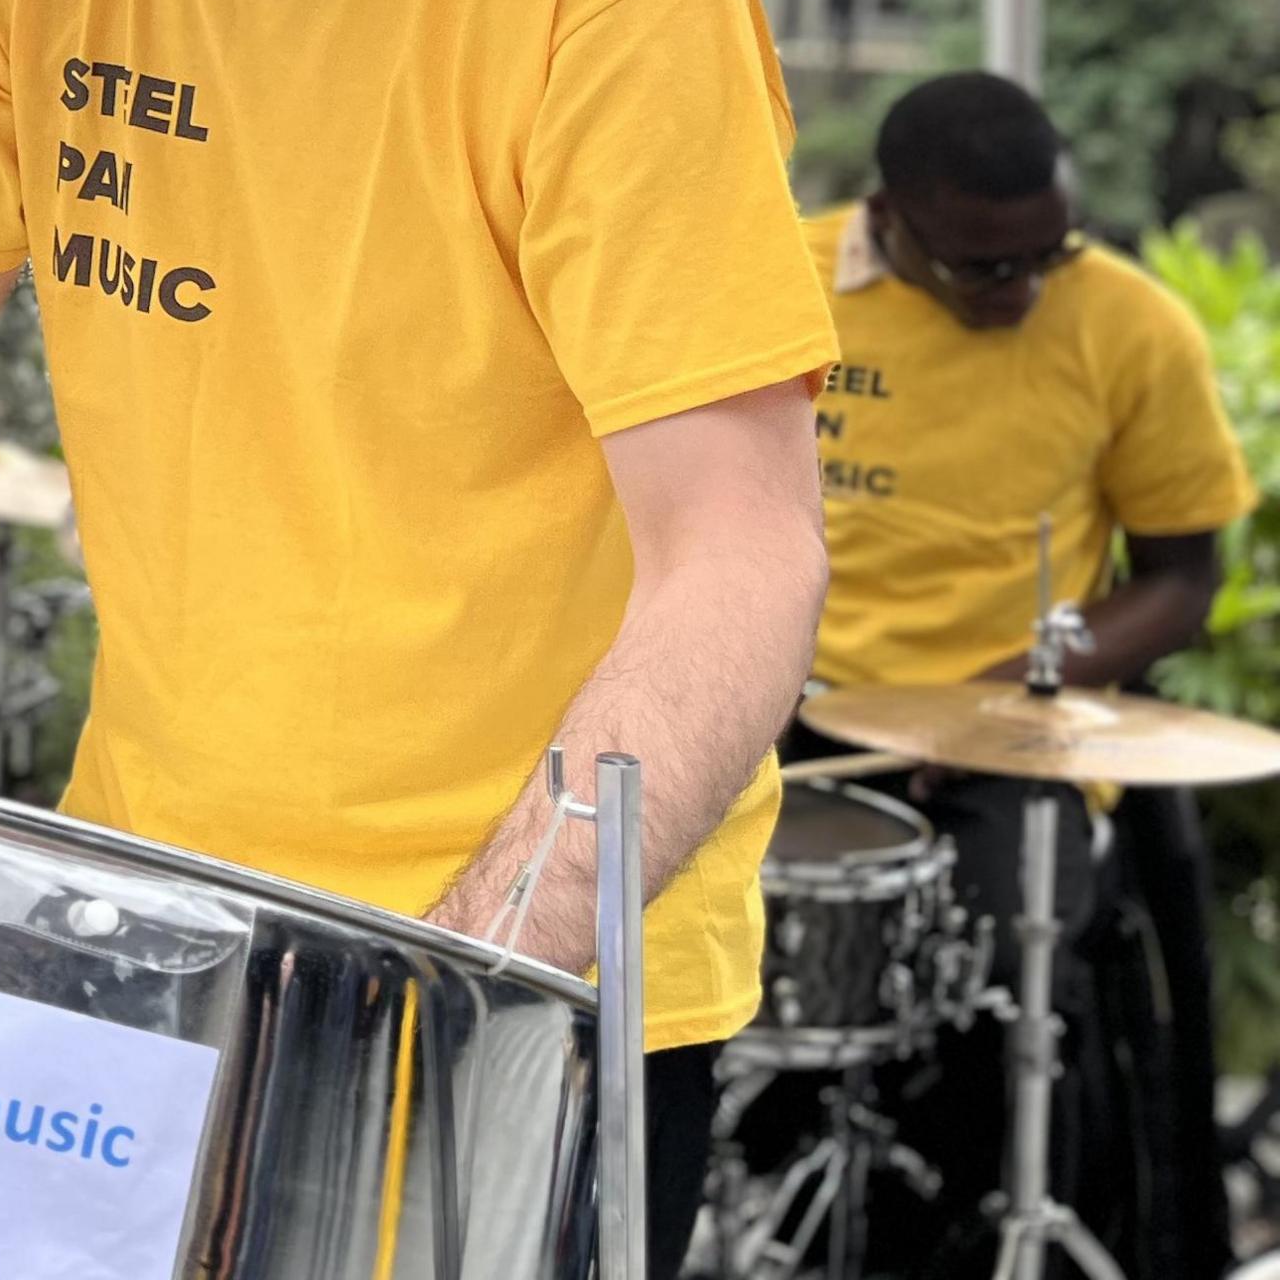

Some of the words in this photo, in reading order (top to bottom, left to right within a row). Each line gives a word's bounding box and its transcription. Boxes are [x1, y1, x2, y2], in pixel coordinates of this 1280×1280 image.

[60, 57, 209, 142] STEL
[52, 224, 217, 323] MUSIC
[826, 363, 892, 399] EEL
[818, 457, 898, 498] SIC
